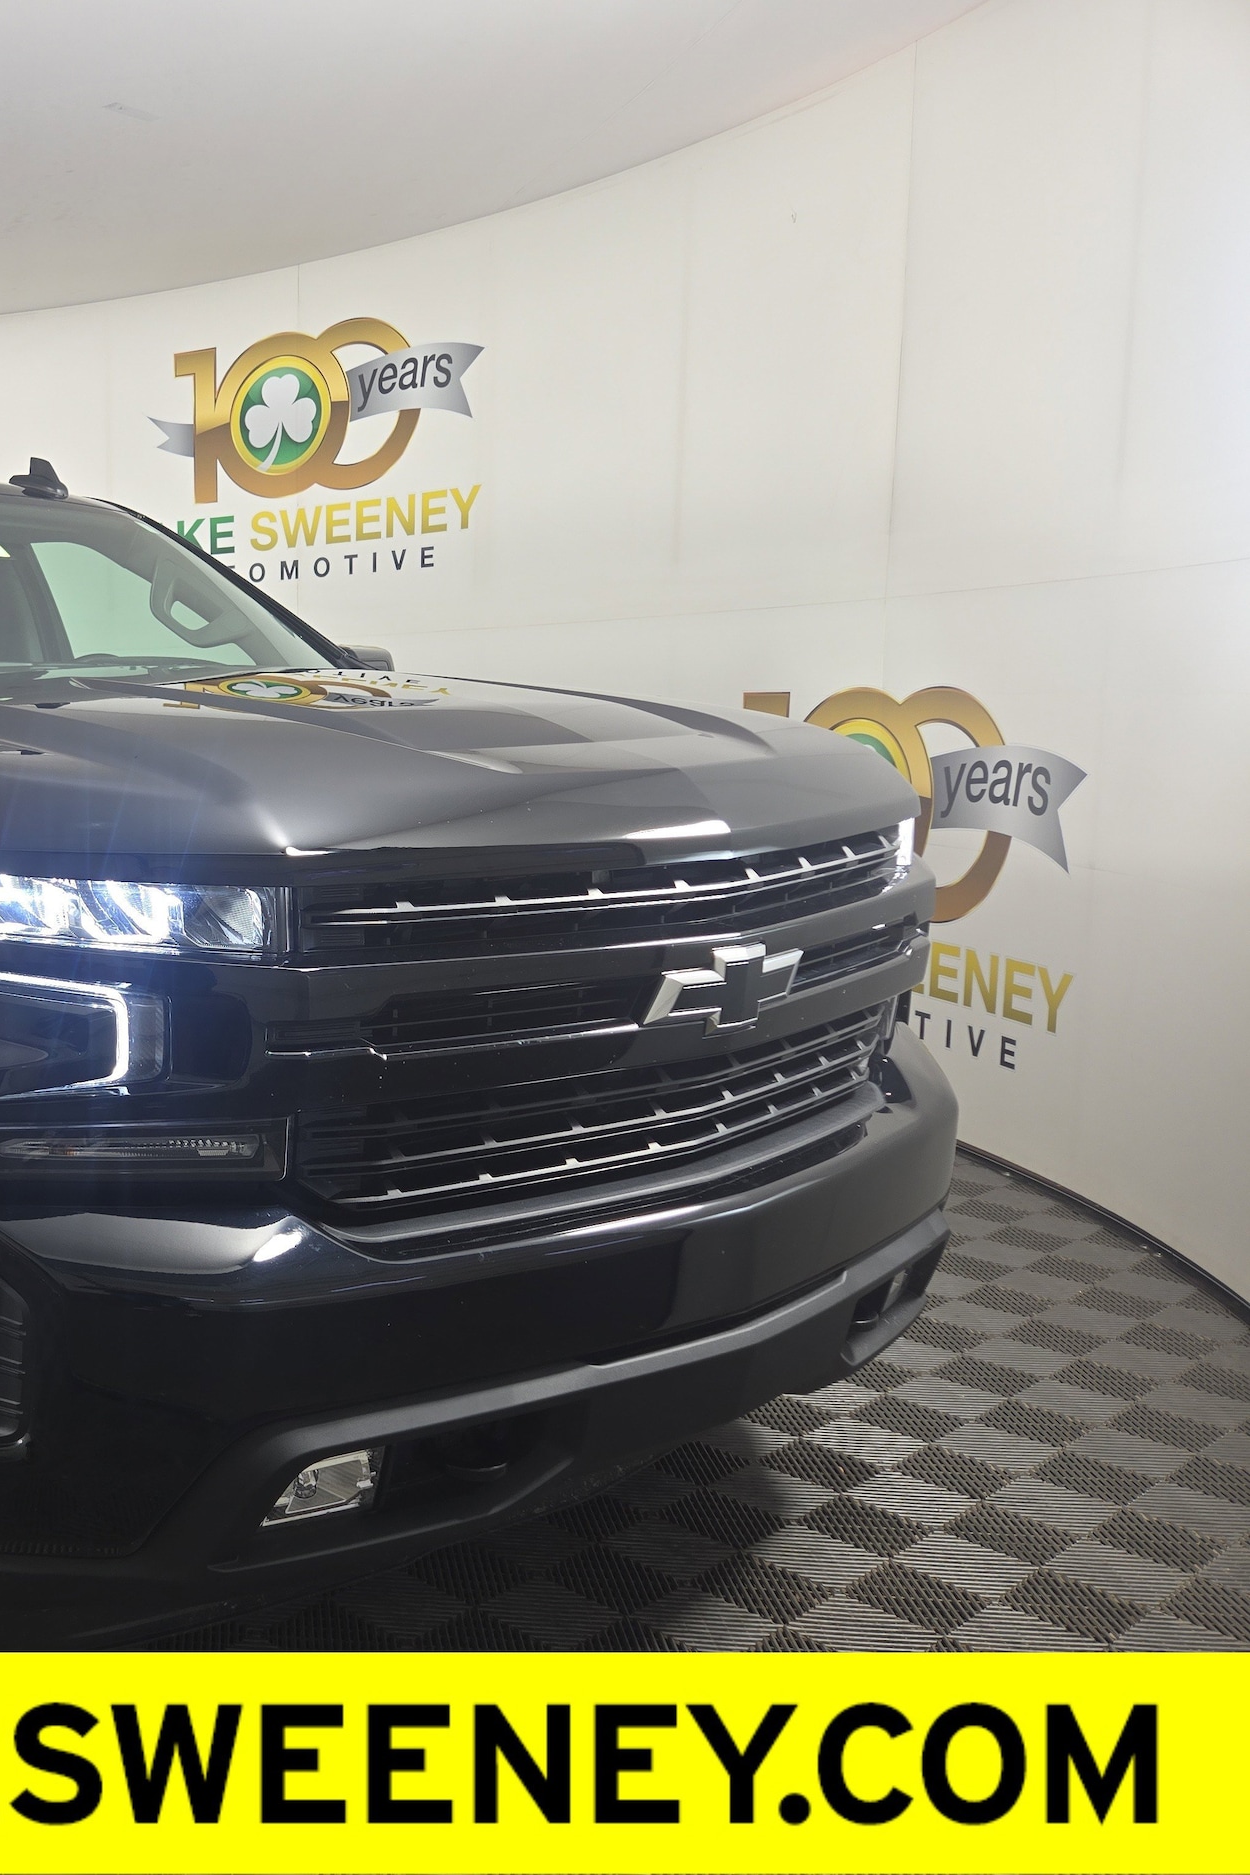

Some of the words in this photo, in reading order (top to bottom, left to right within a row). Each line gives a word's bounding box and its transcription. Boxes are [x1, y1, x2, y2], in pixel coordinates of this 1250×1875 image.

[356, 352, 452, 412] years
[177, 516, 235, 555] KE
[250, 484, 481, 552] SWEENEY
[225, 546, 434, 583] OMOTIVE
[940, 760, 1051, 818] years
[912, 941, 1074, 1034] ENEY
